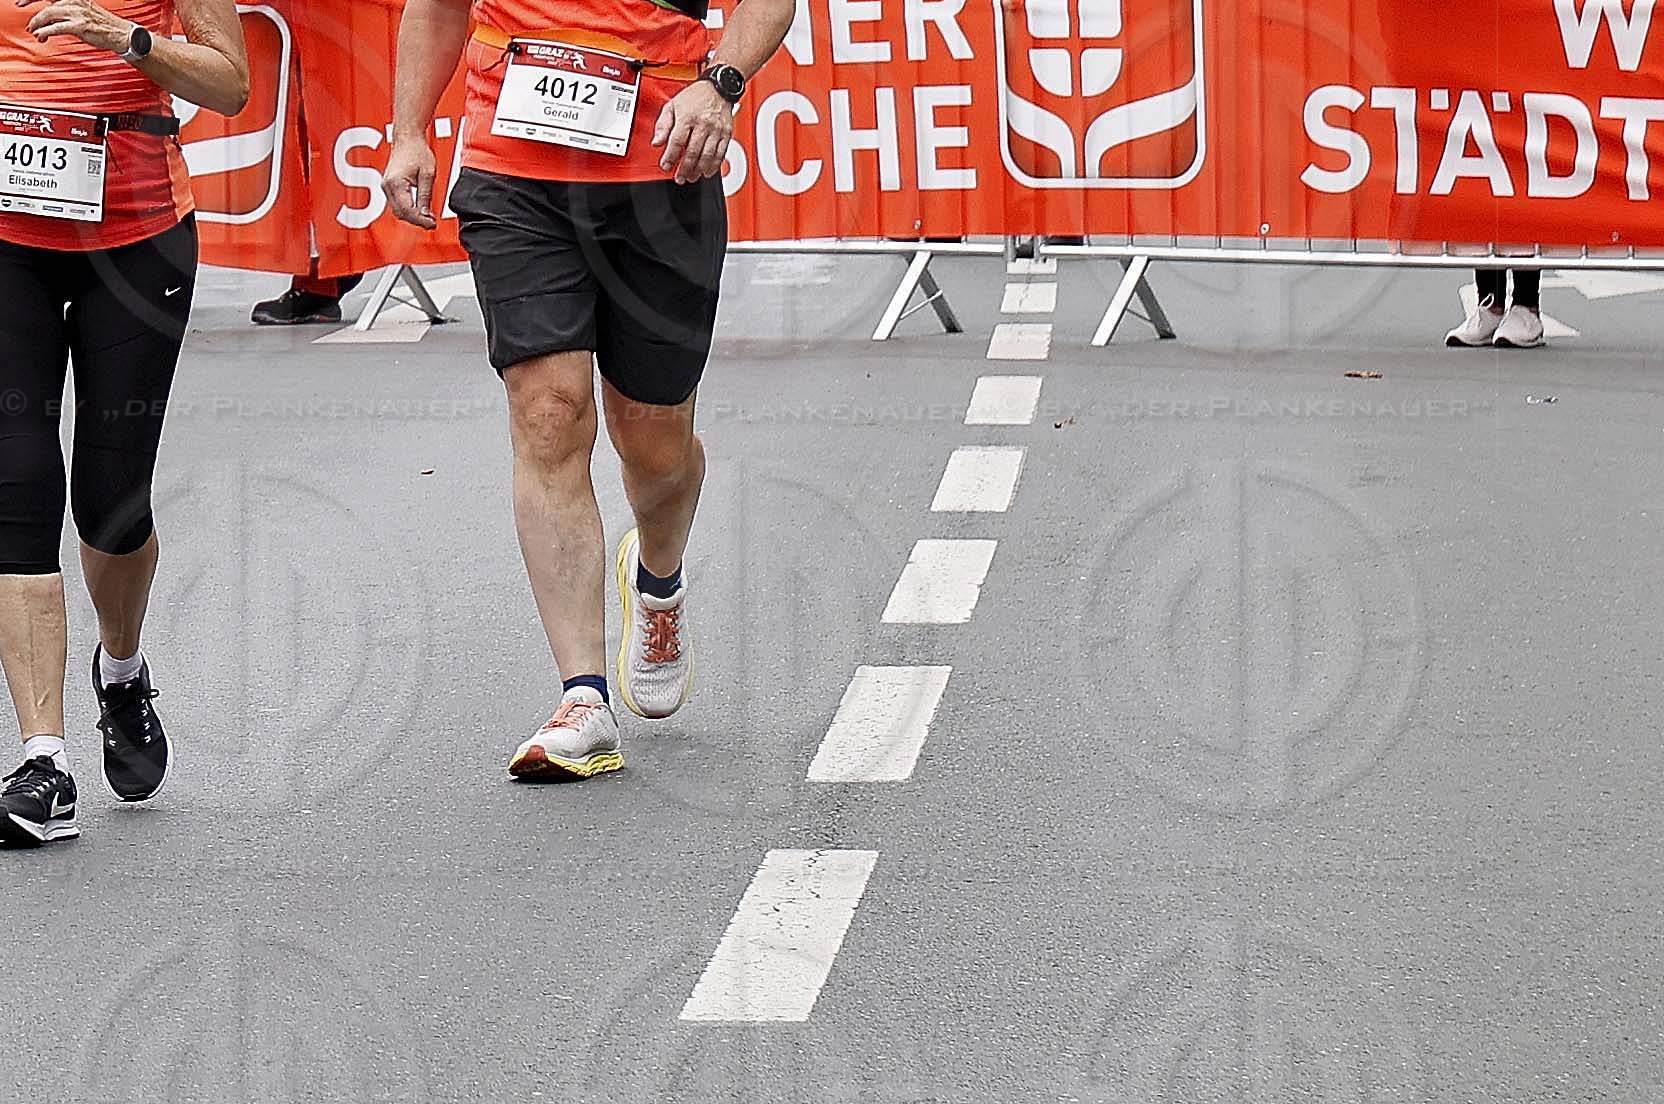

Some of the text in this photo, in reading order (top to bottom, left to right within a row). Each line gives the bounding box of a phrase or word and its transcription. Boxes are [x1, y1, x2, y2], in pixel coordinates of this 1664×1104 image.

[534, 75, 598, 106] 4012
[543, 106, 579, 121] Gerald
[4, 142, 68, 170] 4013
[8, 174, 58, 189] Elisabeth
